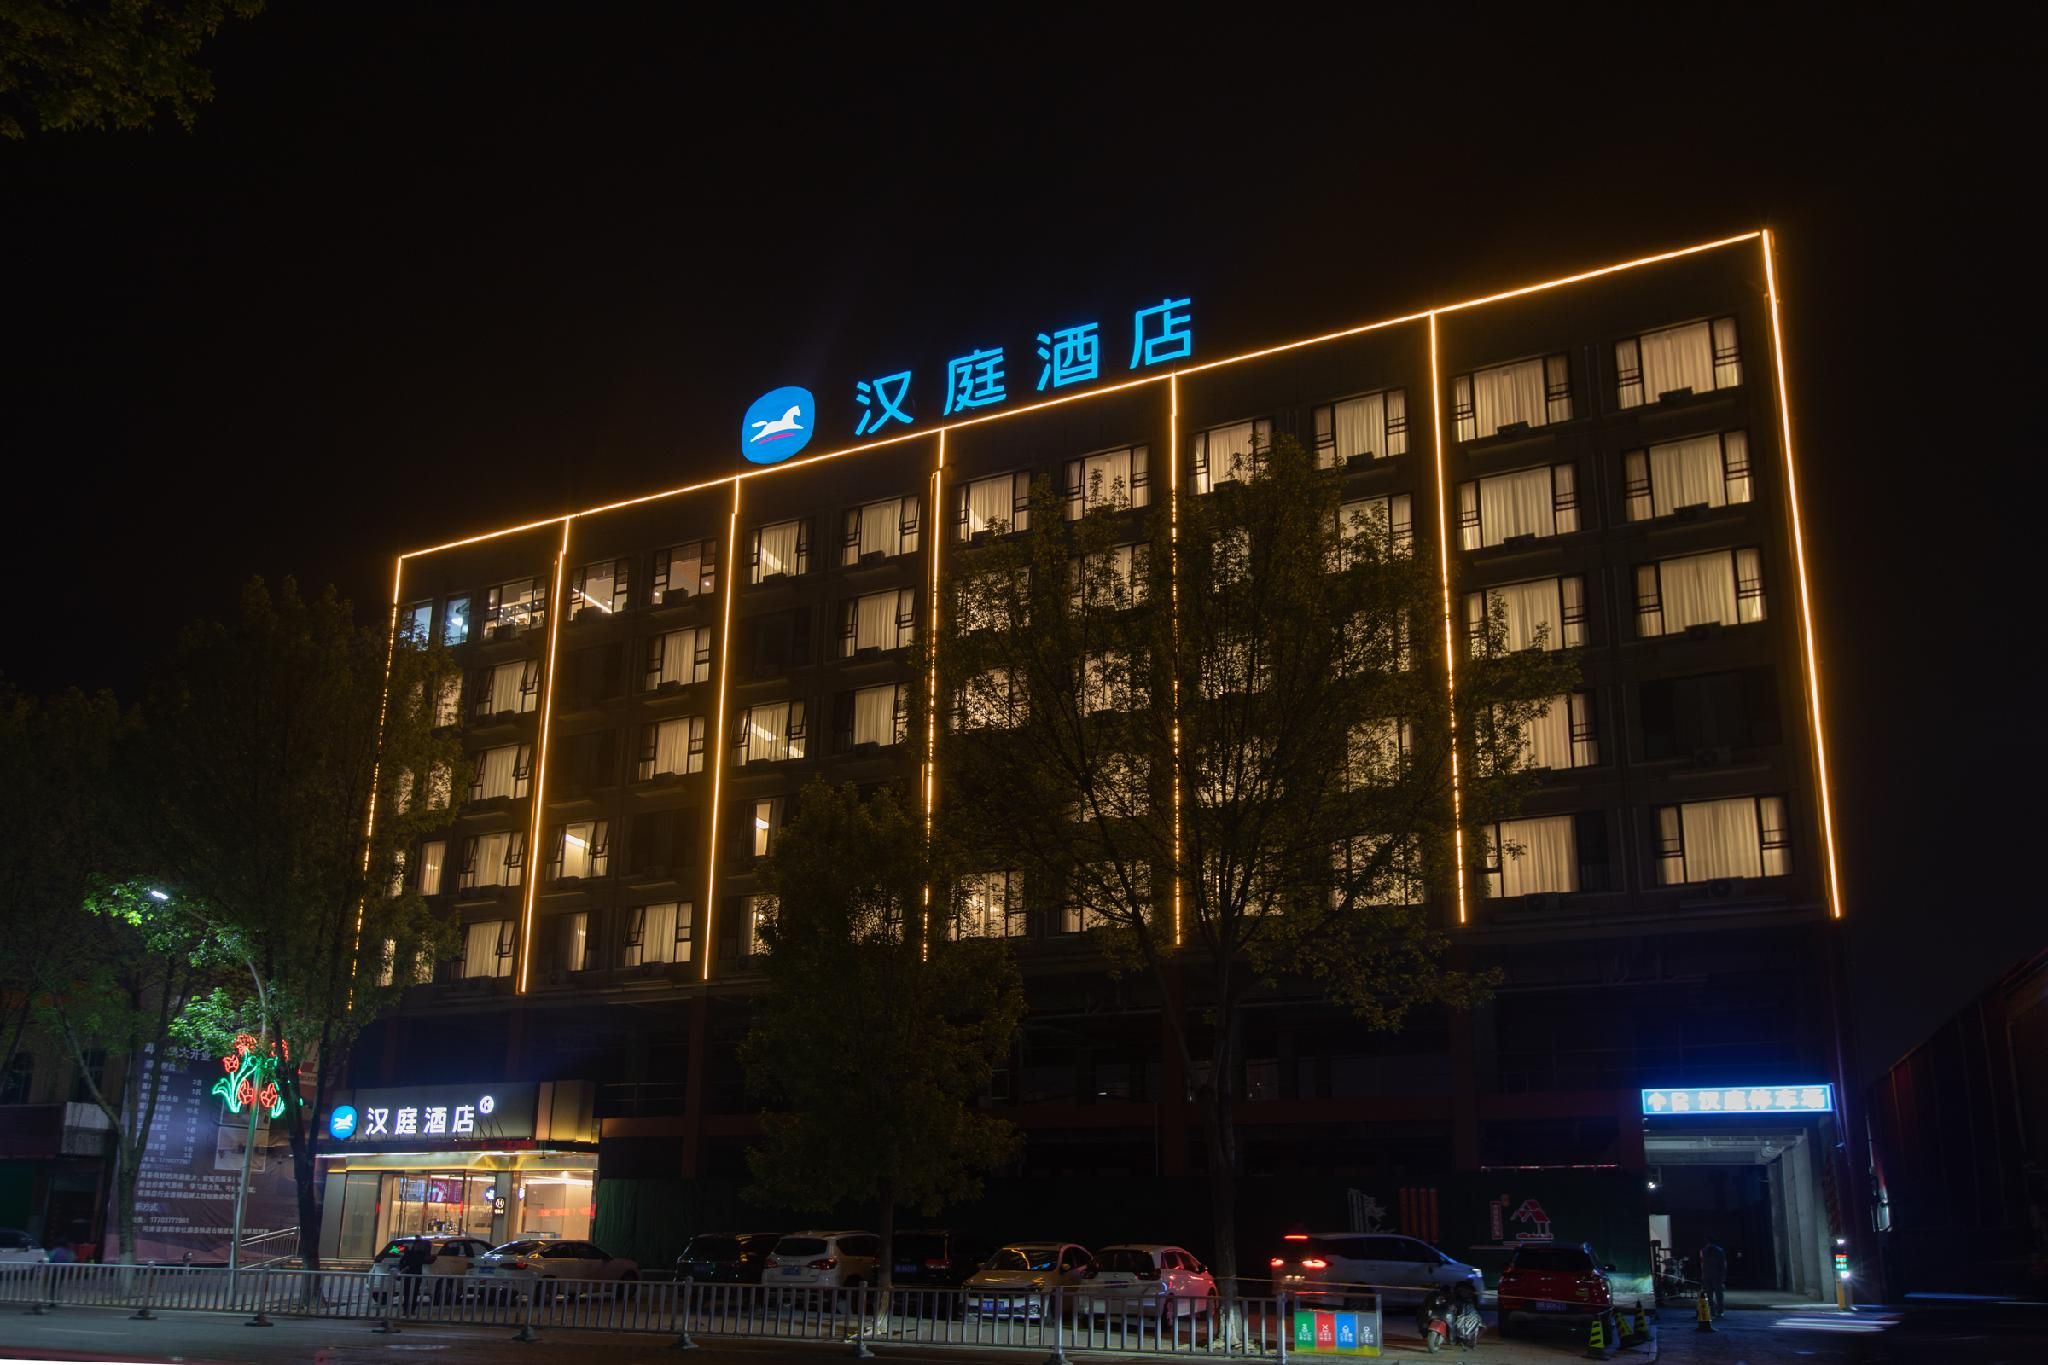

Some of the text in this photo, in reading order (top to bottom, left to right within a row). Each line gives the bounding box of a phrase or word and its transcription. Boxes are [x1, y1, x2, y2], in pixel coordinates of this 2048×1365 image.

[855, 298, 1191, 436] 汉庭酒店
[365, 1104, 475, 1136] 汉庭酒店
